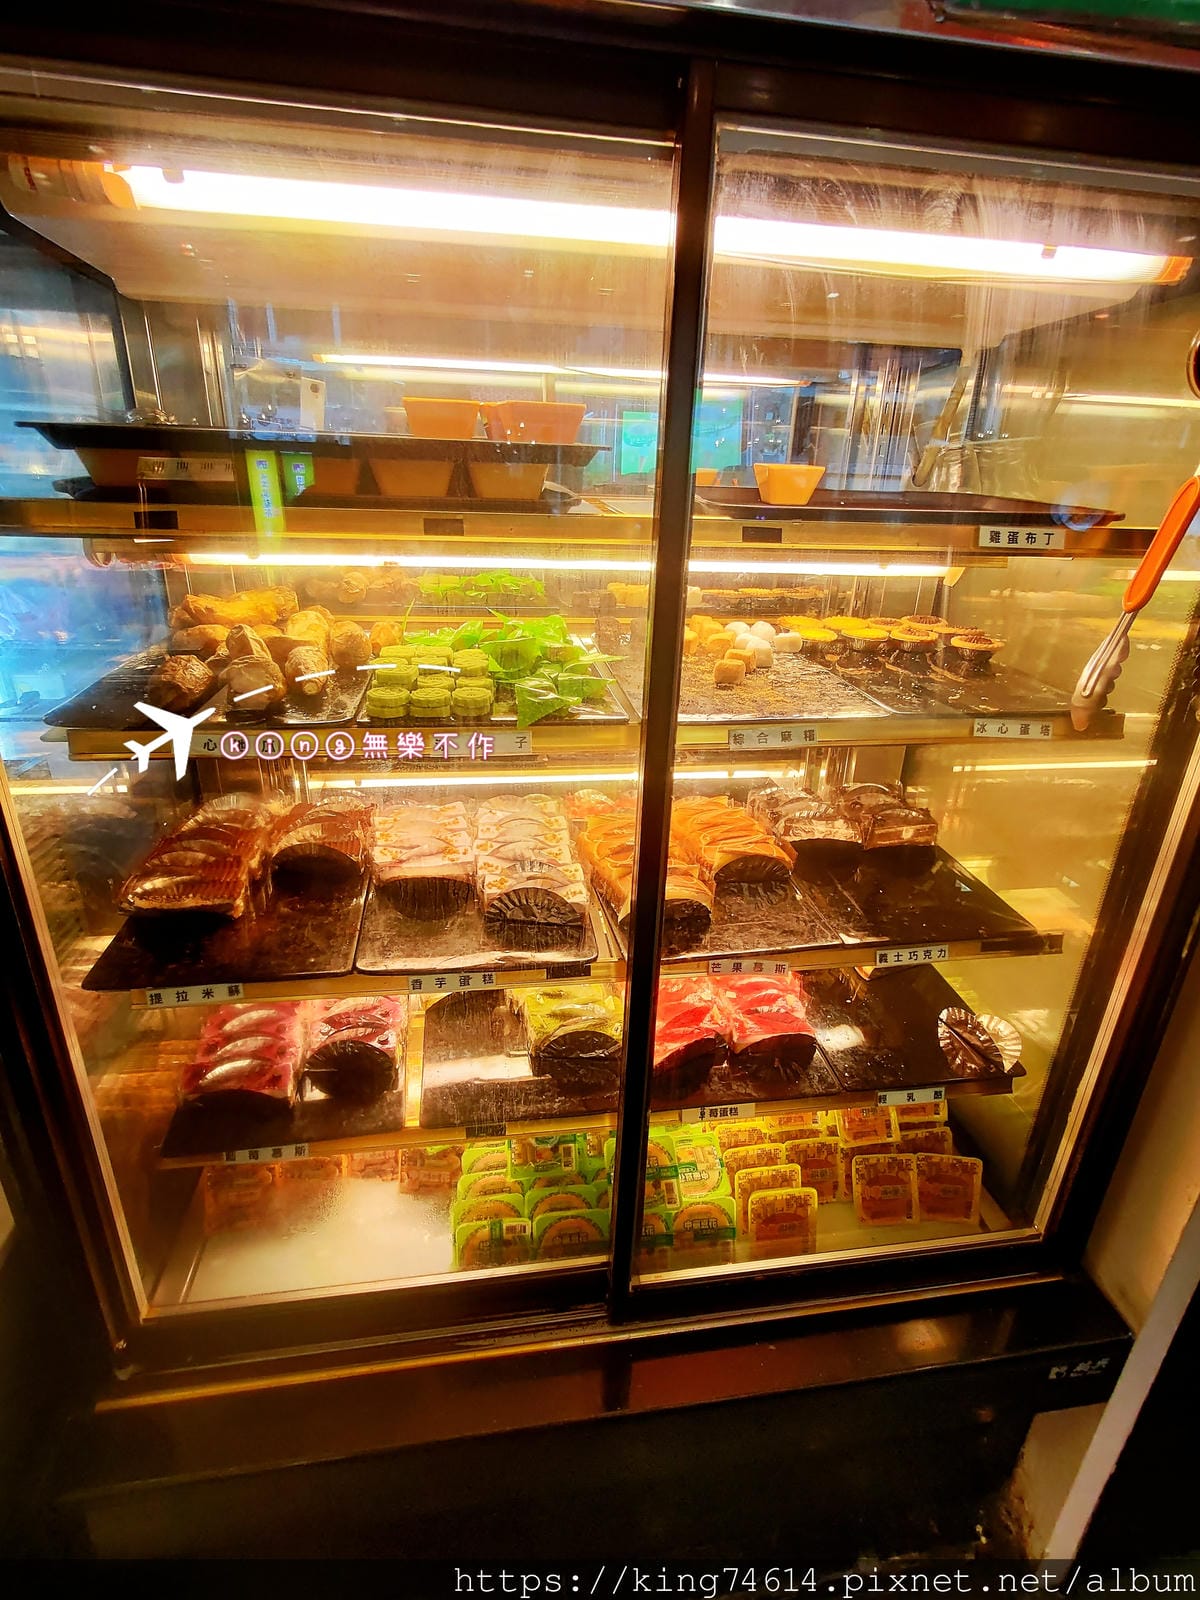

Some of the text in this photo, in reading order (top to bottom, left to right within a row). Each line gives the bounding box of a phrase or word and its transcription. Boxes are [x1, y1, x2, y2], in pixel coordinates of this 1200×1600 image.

[988, 530, 1055, 546] 雞蛋布丁
[975, 722, 1051, 737] 冰心蛋塔
[710, 961, 787, 975] 芒果慕斯
[410, 973, 494, 991] 香芋蛋糕
[148, 984, 241, 1006] 提拉米蘇
